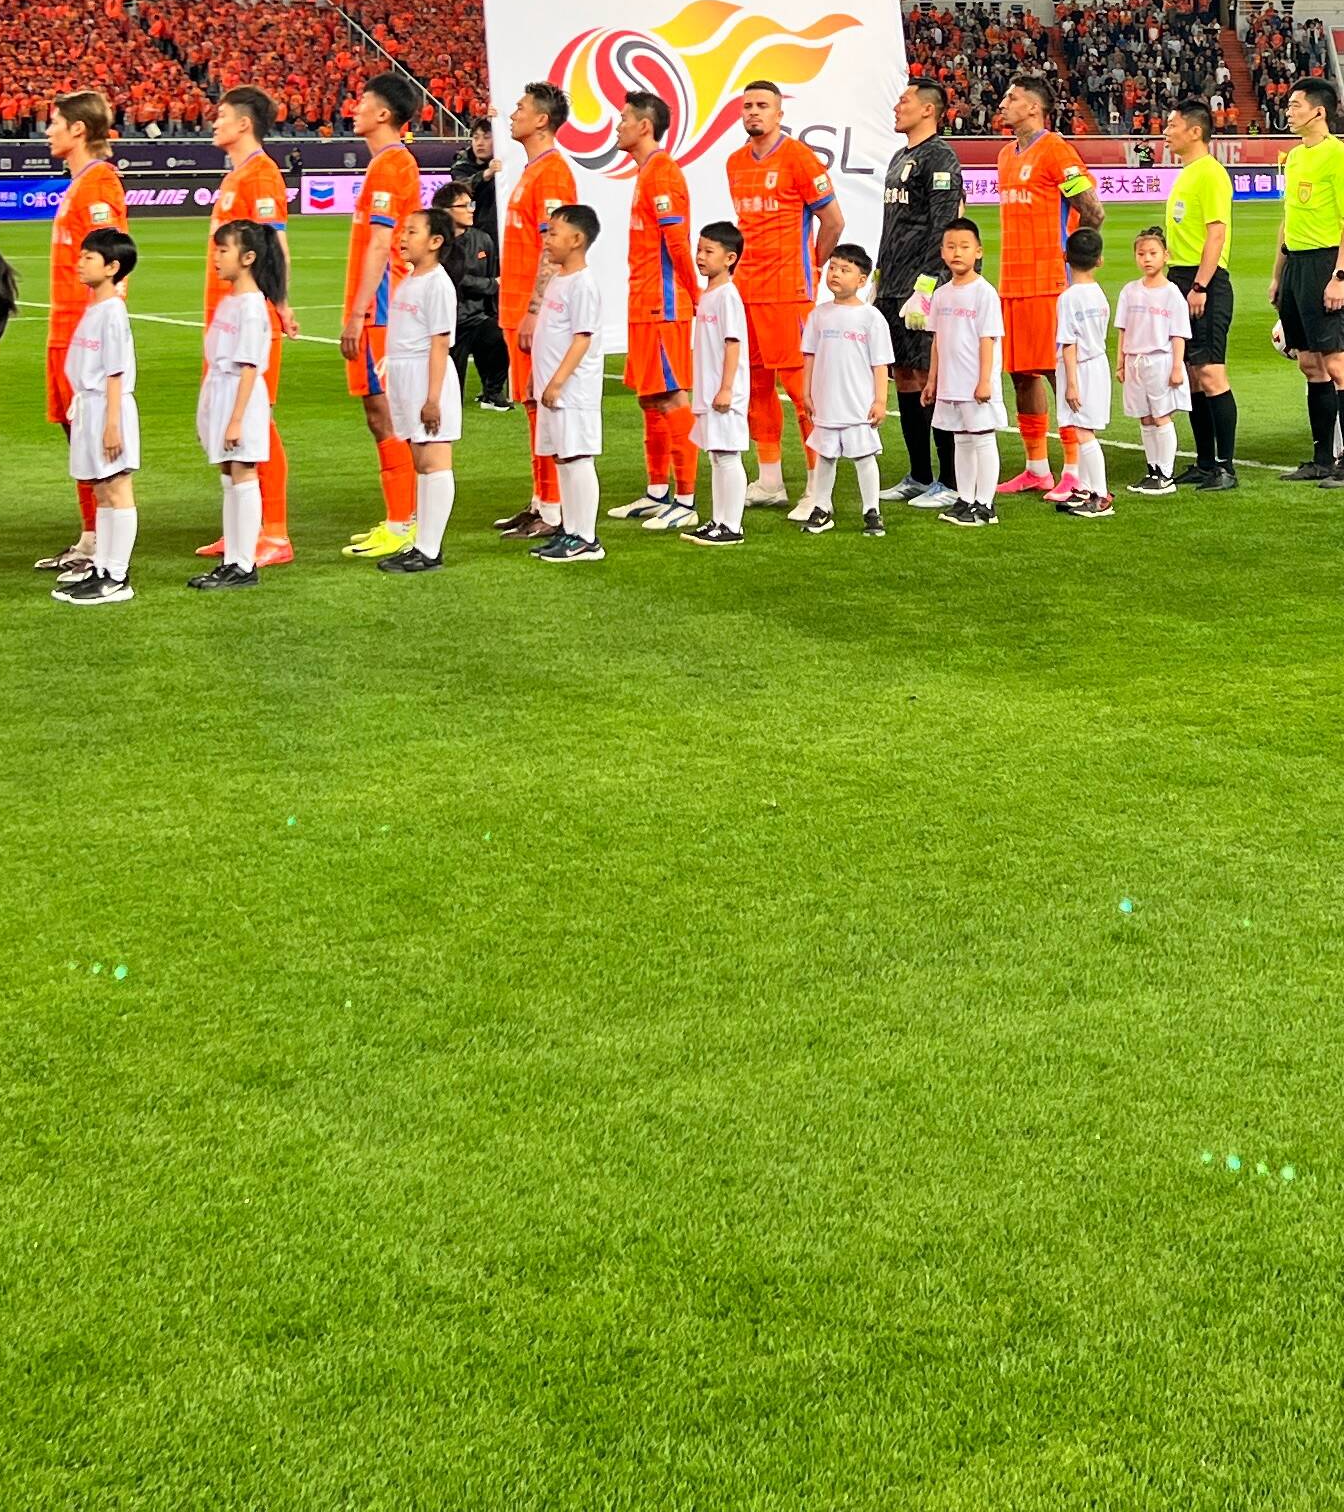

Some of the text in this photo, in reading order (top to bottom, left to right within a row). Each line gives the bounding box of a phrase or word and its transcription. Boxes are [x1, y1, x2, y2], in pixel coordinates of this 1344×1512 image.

[1099, 175, 1162, 194] 英大金融
[124, 188, 190, 206] ONLINE
